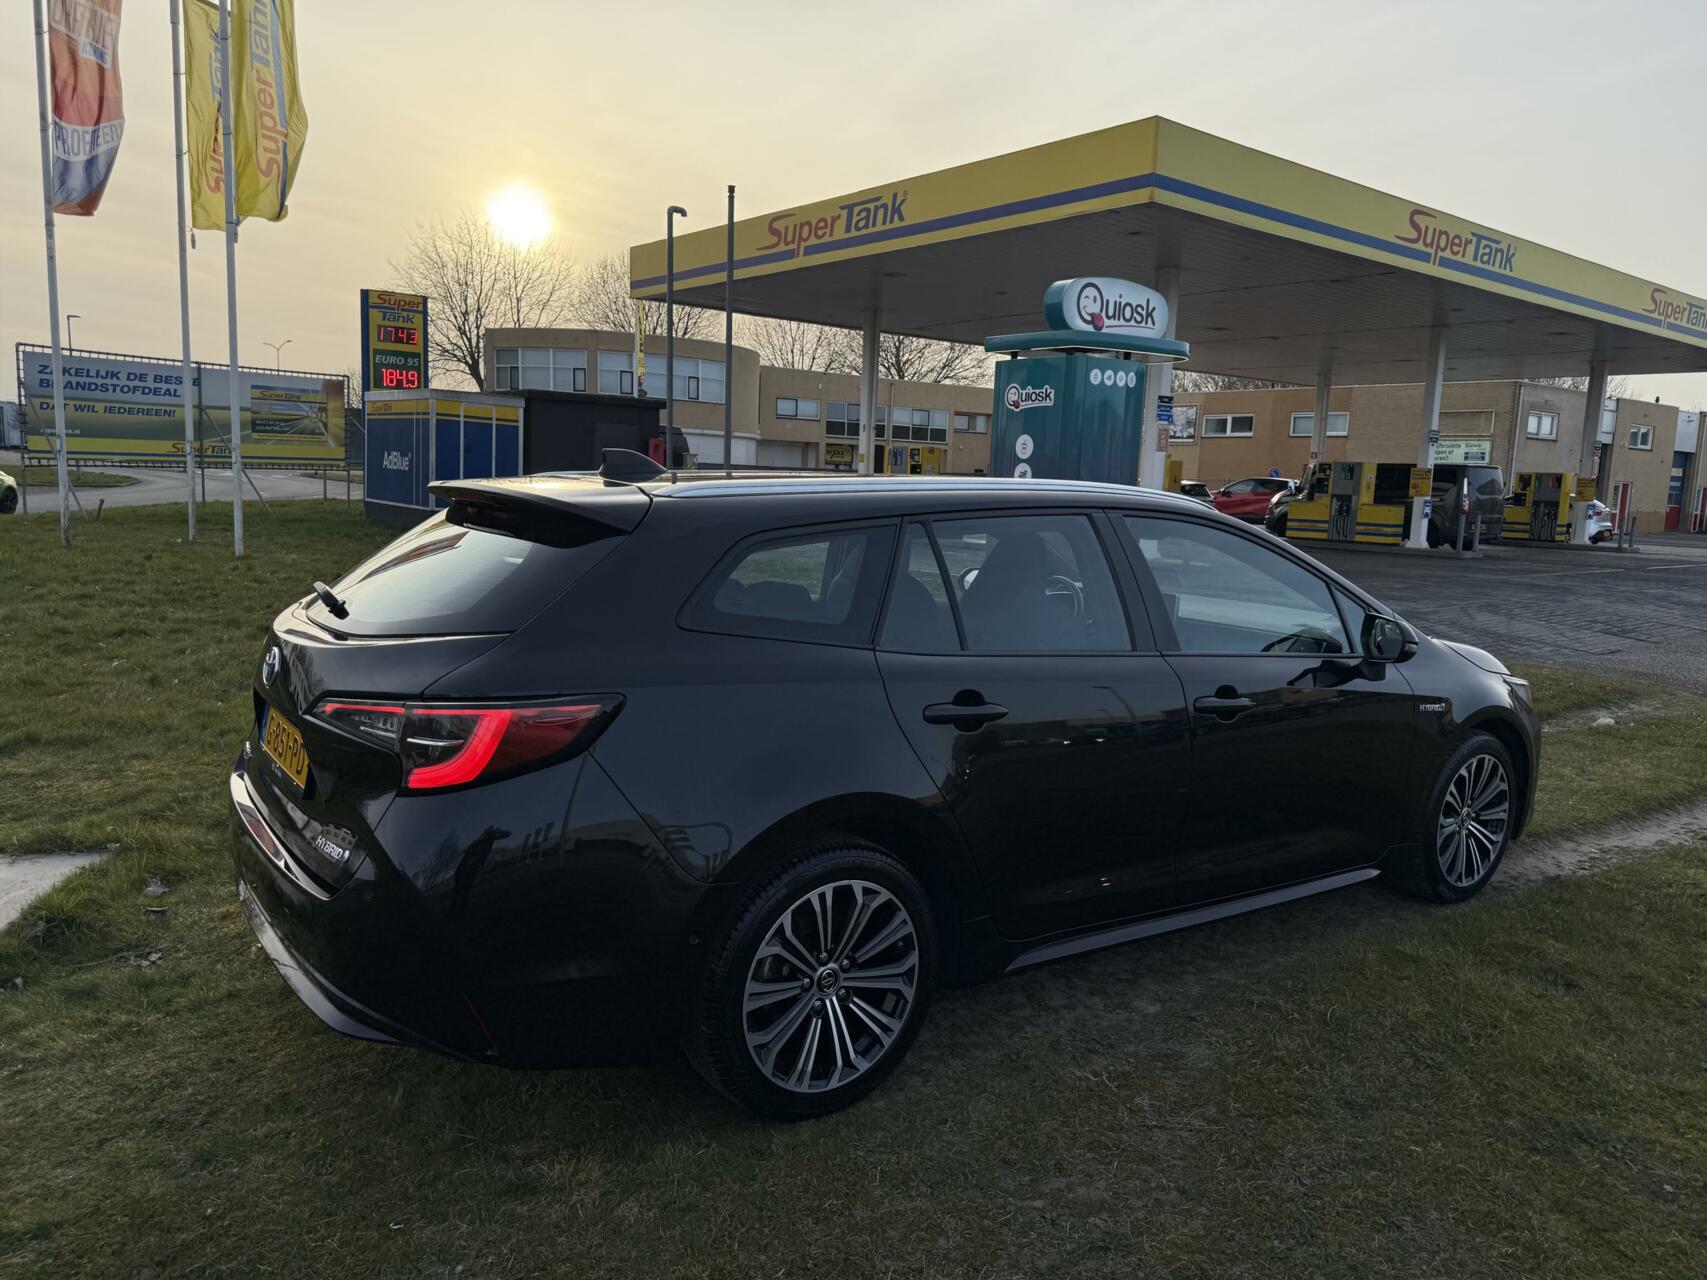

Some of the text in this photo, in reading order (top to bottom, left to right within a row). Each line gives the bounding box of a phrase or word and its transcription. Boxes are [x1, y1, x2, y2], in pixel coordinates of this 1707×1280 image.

[756, 191, 908, 258] SuperTank
[1394, 208, 1518, 273] SuperTank
[372, 293, 422, 312] Super
[1077, 282, 1156, 330] Quiosk
[1641, 288, 1707, 329] SuperTan
[379, 311, 415, 324] Tank
[375, 354, 420, 367] EURO 95
[37, 364, 201, 387] ZKELIJK DE BESE
[38, 378, 182, 398] BANDSTOFDEAL
[1006, 385, 1053, 408] Quiosk
[73, 403, 99, 414] WIL
[103, 405, 176, 418] IEDEREEN!
[315, 835, 344, 860] HYBRID
